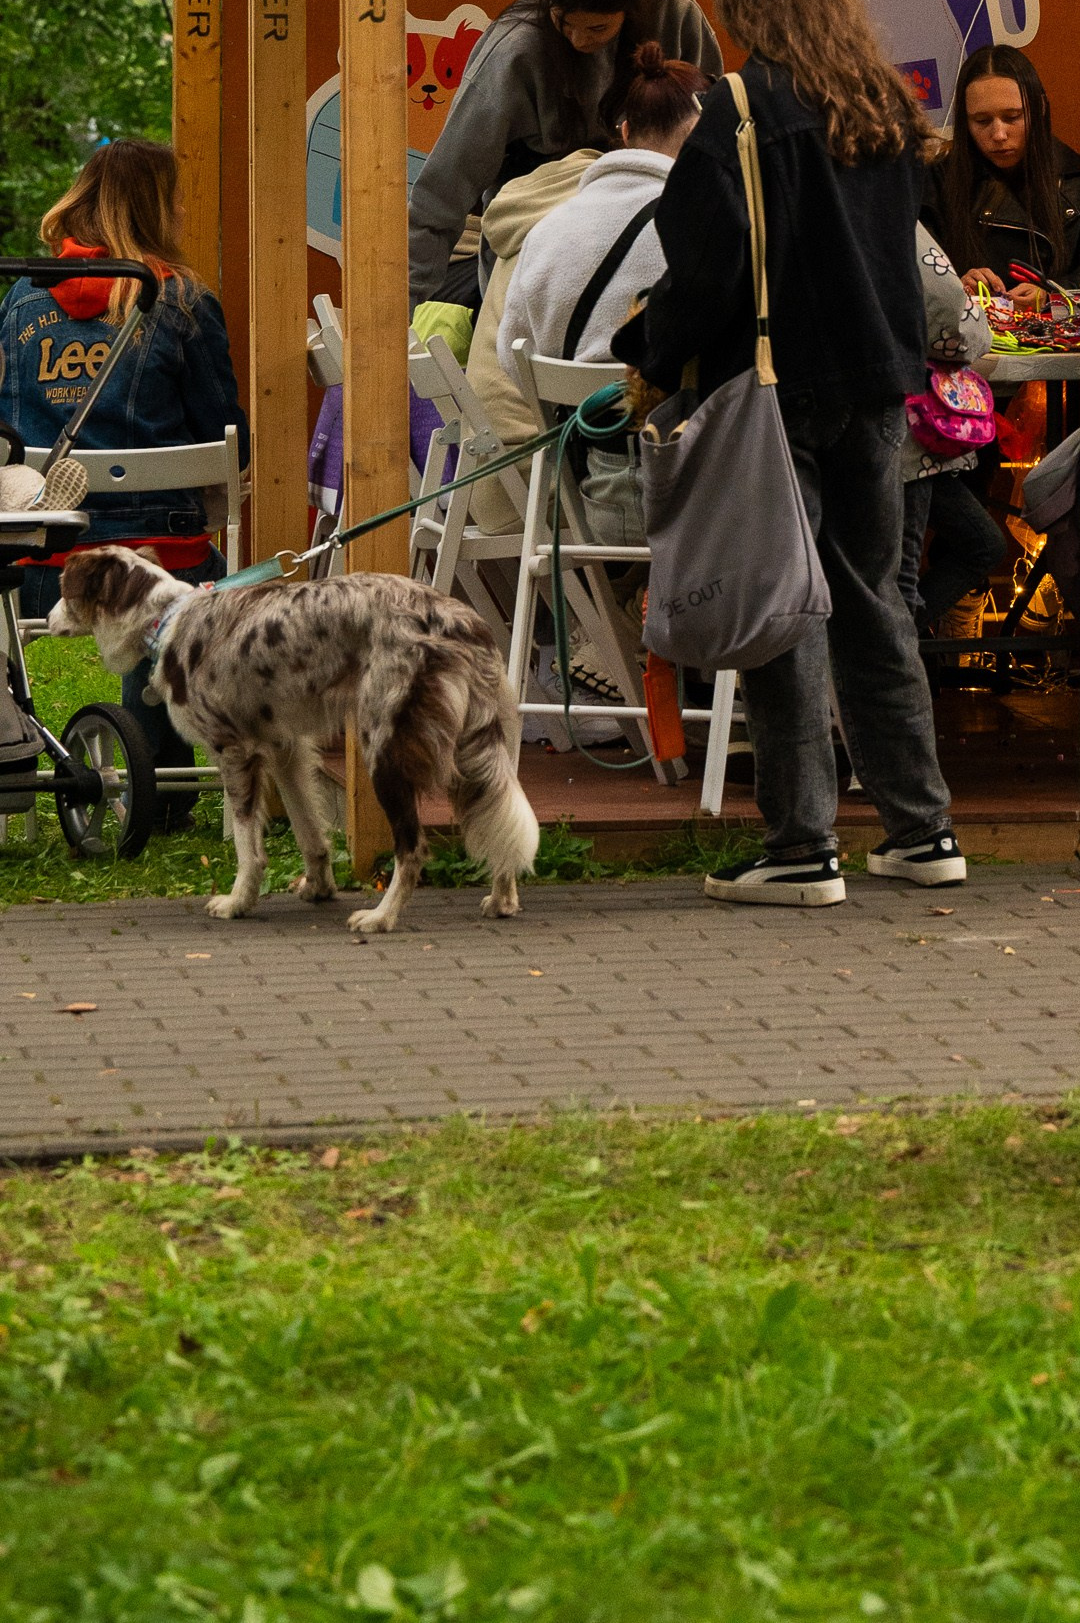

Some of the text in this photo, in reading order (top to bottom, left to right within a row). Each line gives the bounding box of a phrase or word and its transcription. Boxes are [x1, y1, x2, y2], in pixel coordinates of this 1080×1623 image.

[17, 322, 36, 342] THE
[38, 337, 111, 381] Lee
[45, 386, 90, 399] WORKWEA
[688, 579, 723, 607] OUT
